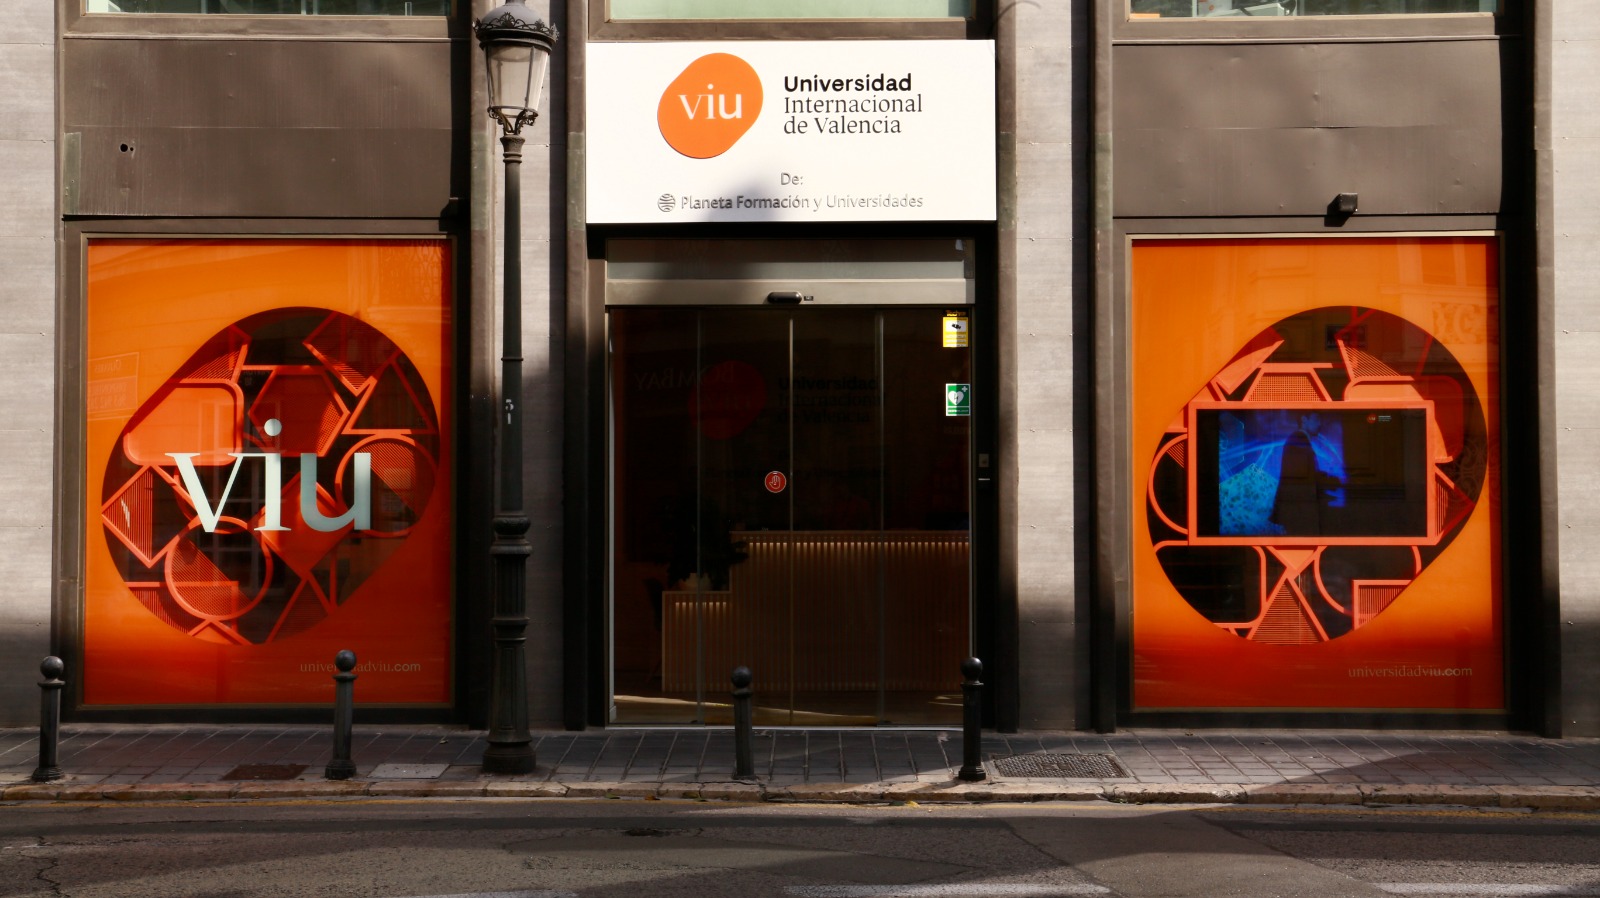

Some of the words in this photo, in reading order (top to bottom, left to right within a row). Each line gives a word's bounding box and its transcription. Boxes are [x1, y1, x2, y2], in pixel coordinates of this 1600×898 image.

[784, 73, 912, 92] Universidad
[678, 83, 742, 120] viu
[784, 94, 923, 113] Internacional
[783, 115, 808, 134] de
[813, 115, 902, 134] Valencia
[780, 172, 804, 186] De:
[681, 195, 733, 210] Planeta
[736, 194, 810, 209] Formación
[812, 198, 822, 213] y
[826, 193, 924, 208] Universidades
[165, 418, 372, 533] viu
[1348, 665, 1473, 677] universidadviu.com
